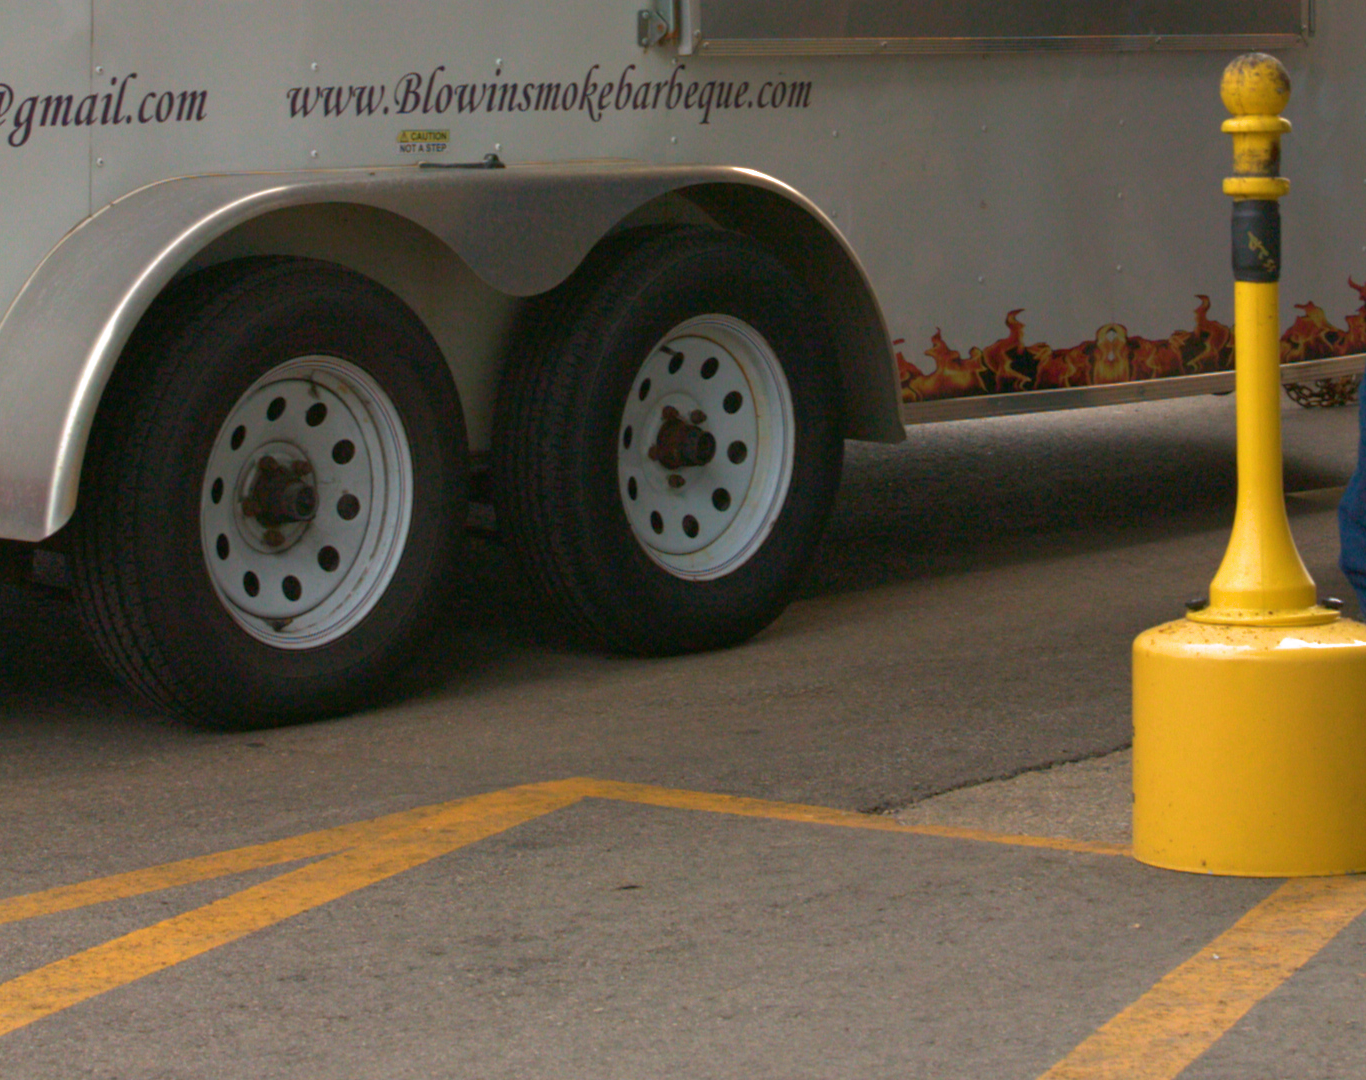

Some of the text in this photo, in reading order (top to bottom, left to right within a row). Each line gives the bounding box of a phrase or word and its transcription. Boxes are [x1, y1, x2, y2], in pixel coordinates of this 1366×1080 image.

[285, 64, 812, 124] www.Blowinsmokebarbeque.com
[411, 131, 447, 141] CAUTION
[399, 143, 447, 153] NOT A STEP
